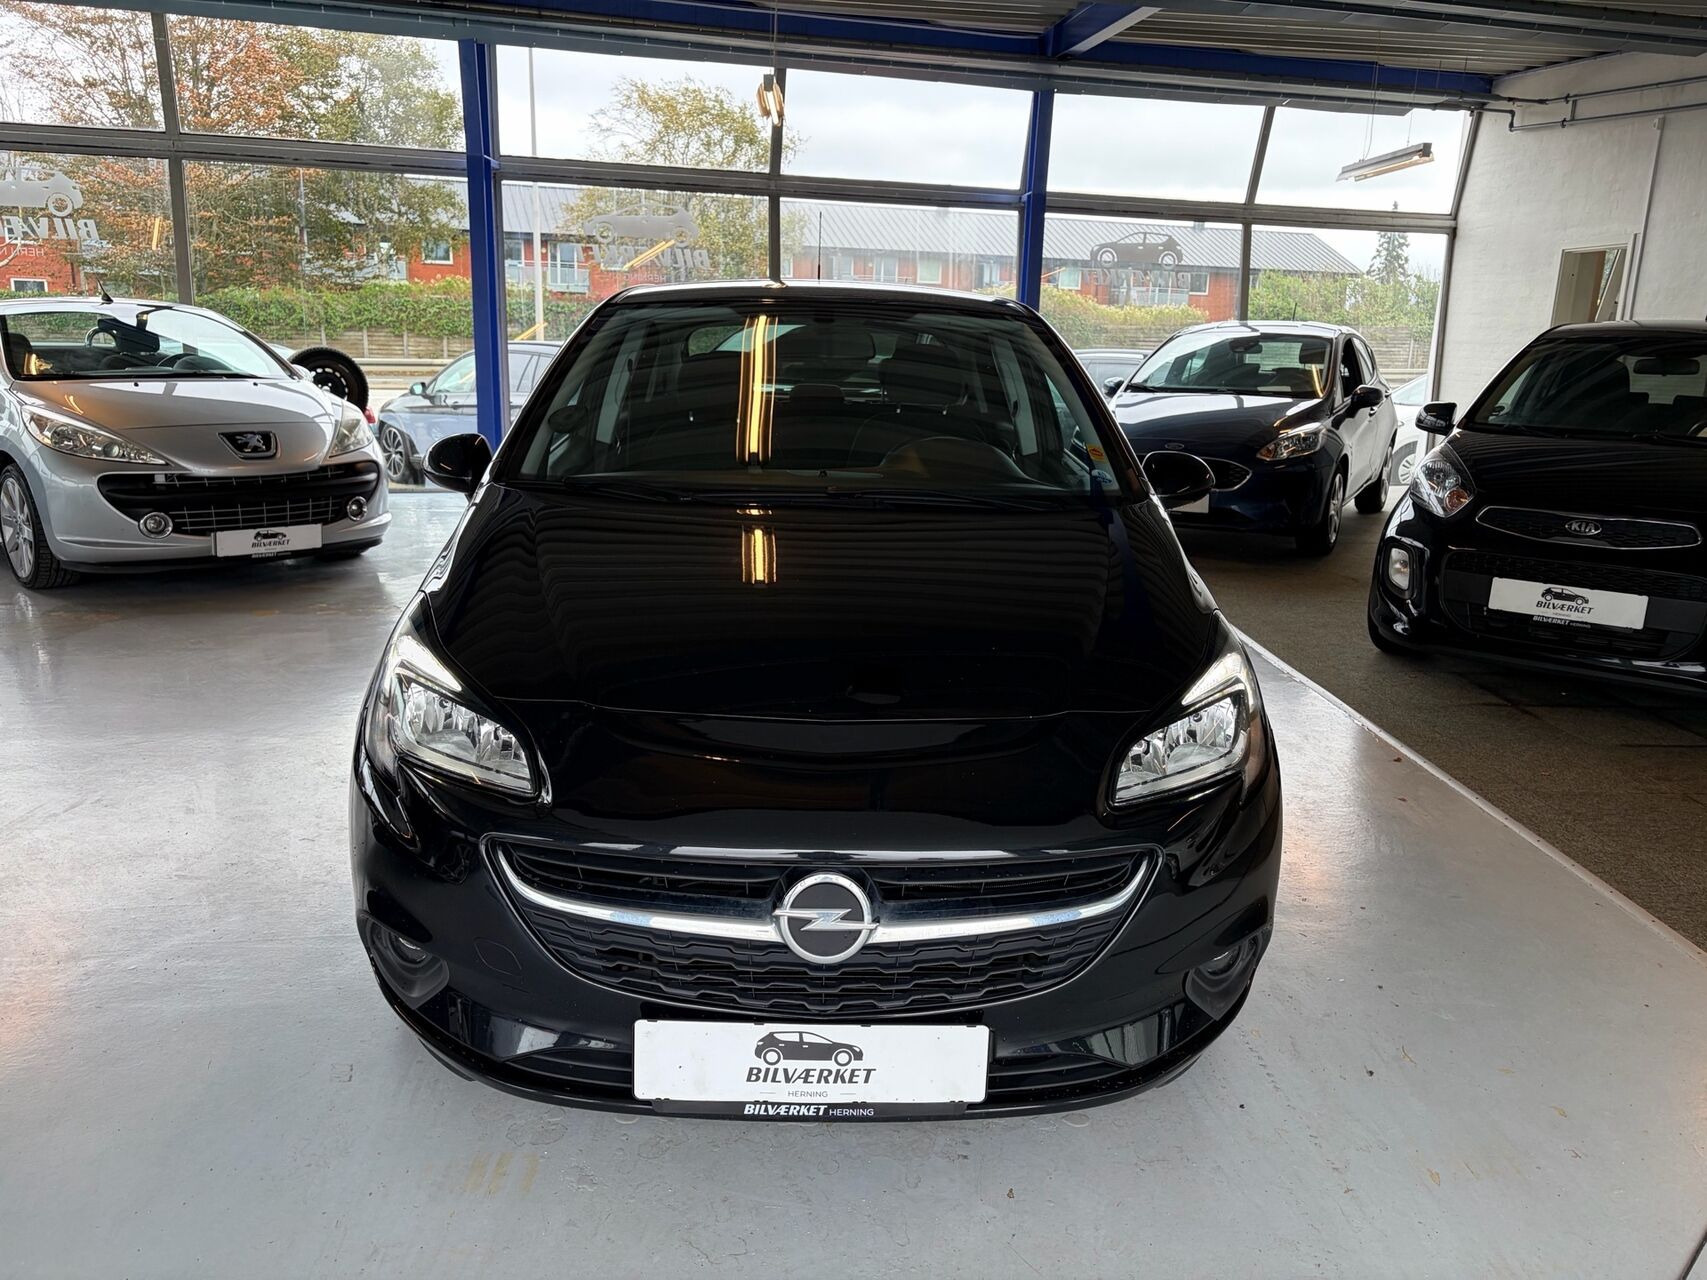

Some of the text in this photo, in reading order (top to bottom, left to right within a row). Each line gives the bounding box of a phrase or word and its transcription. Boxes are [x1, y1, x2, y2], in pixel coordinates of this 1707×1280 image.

[1570, 521, 1596, 533] KIA
[1536, 600, 1594, 614] BILVÆRKET
[746, 1066, 876, 1084] BILVÆRKET
[787, 1090, 829, 1098] HERNING
[743, 1104, 874, 1116] BILVÆRKET HERNING
